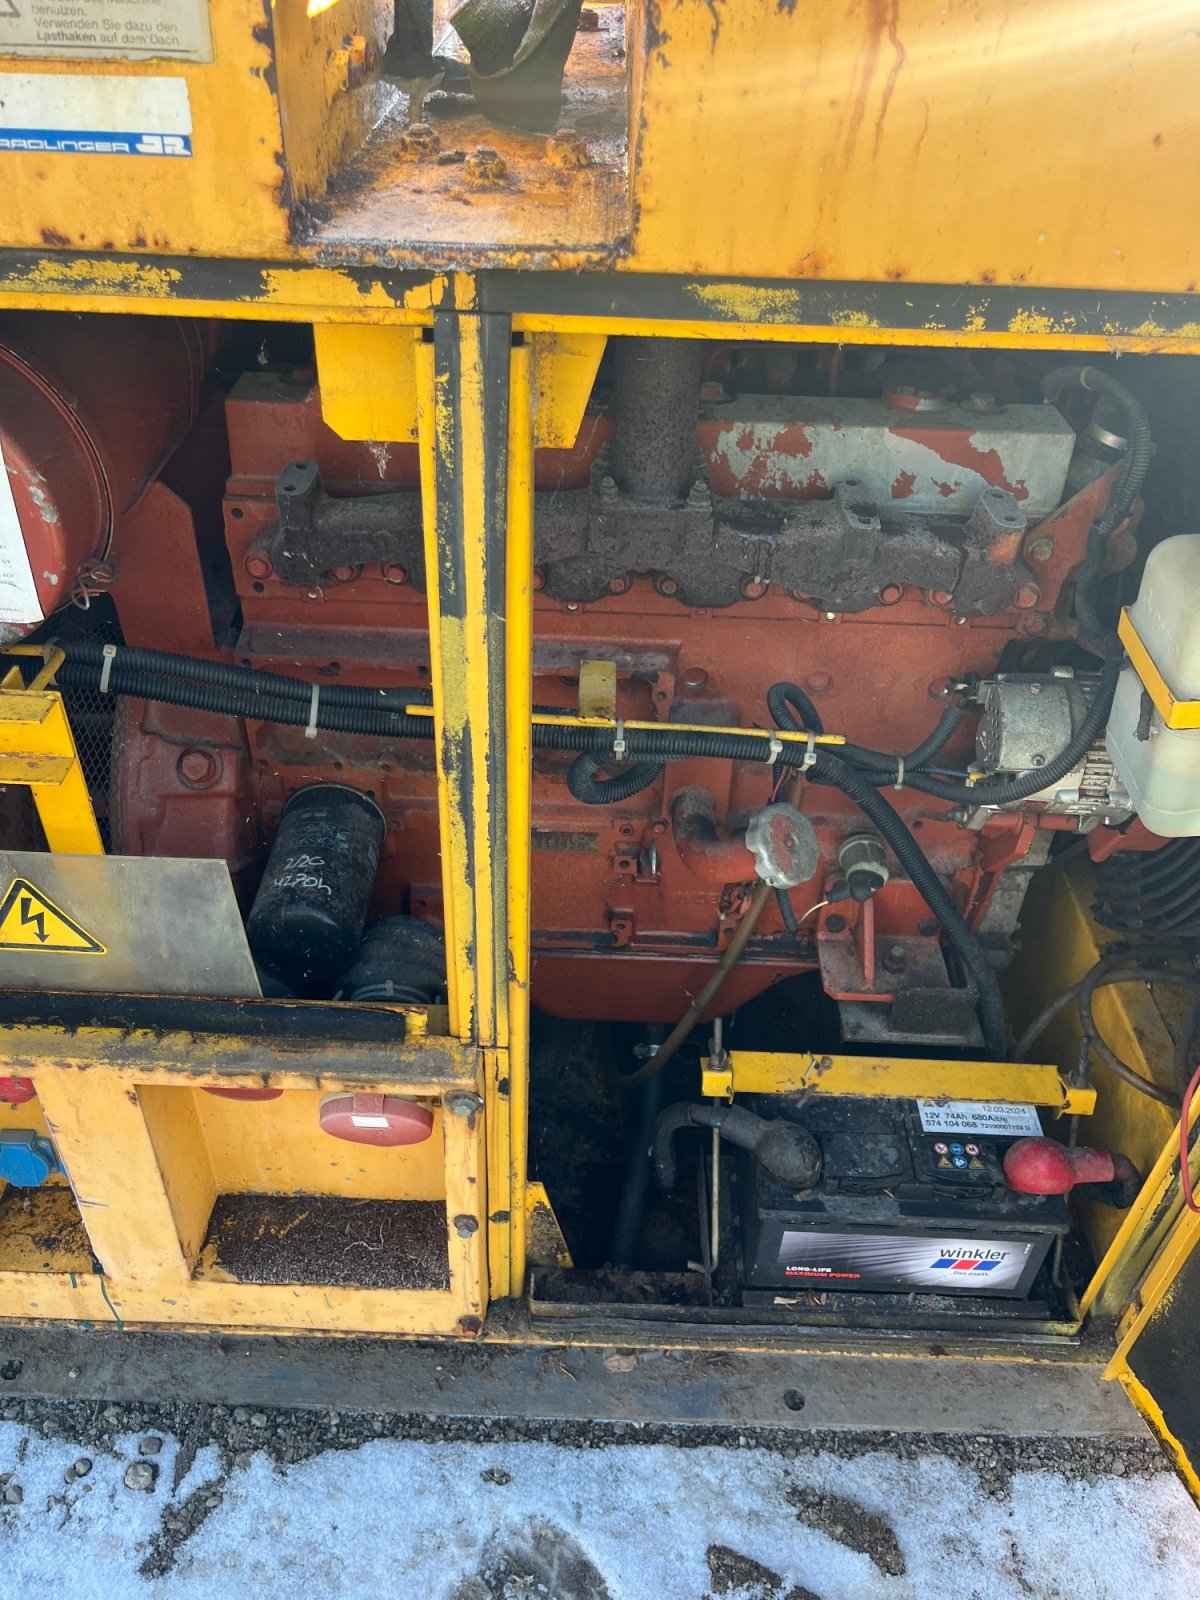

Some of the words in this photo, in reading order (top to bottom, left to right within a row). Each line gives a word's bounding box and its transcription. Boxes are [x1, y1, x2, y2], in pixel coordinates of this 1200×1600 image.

[31, 3, 88, 16] benutzen.
[35, 17, 99, 29] Verwenden
[102, 18, 121, 30] Sie
[124, 19, 153, 31] dazu
[155, 21, 178, 32] den
[37, 30, 97, 42] Lasthaken
[99, 31, 118, 43] auf
[982, 1105, 1027, 1114] 12.03.2024
[940, 1247, 1011, 1261] winkler
